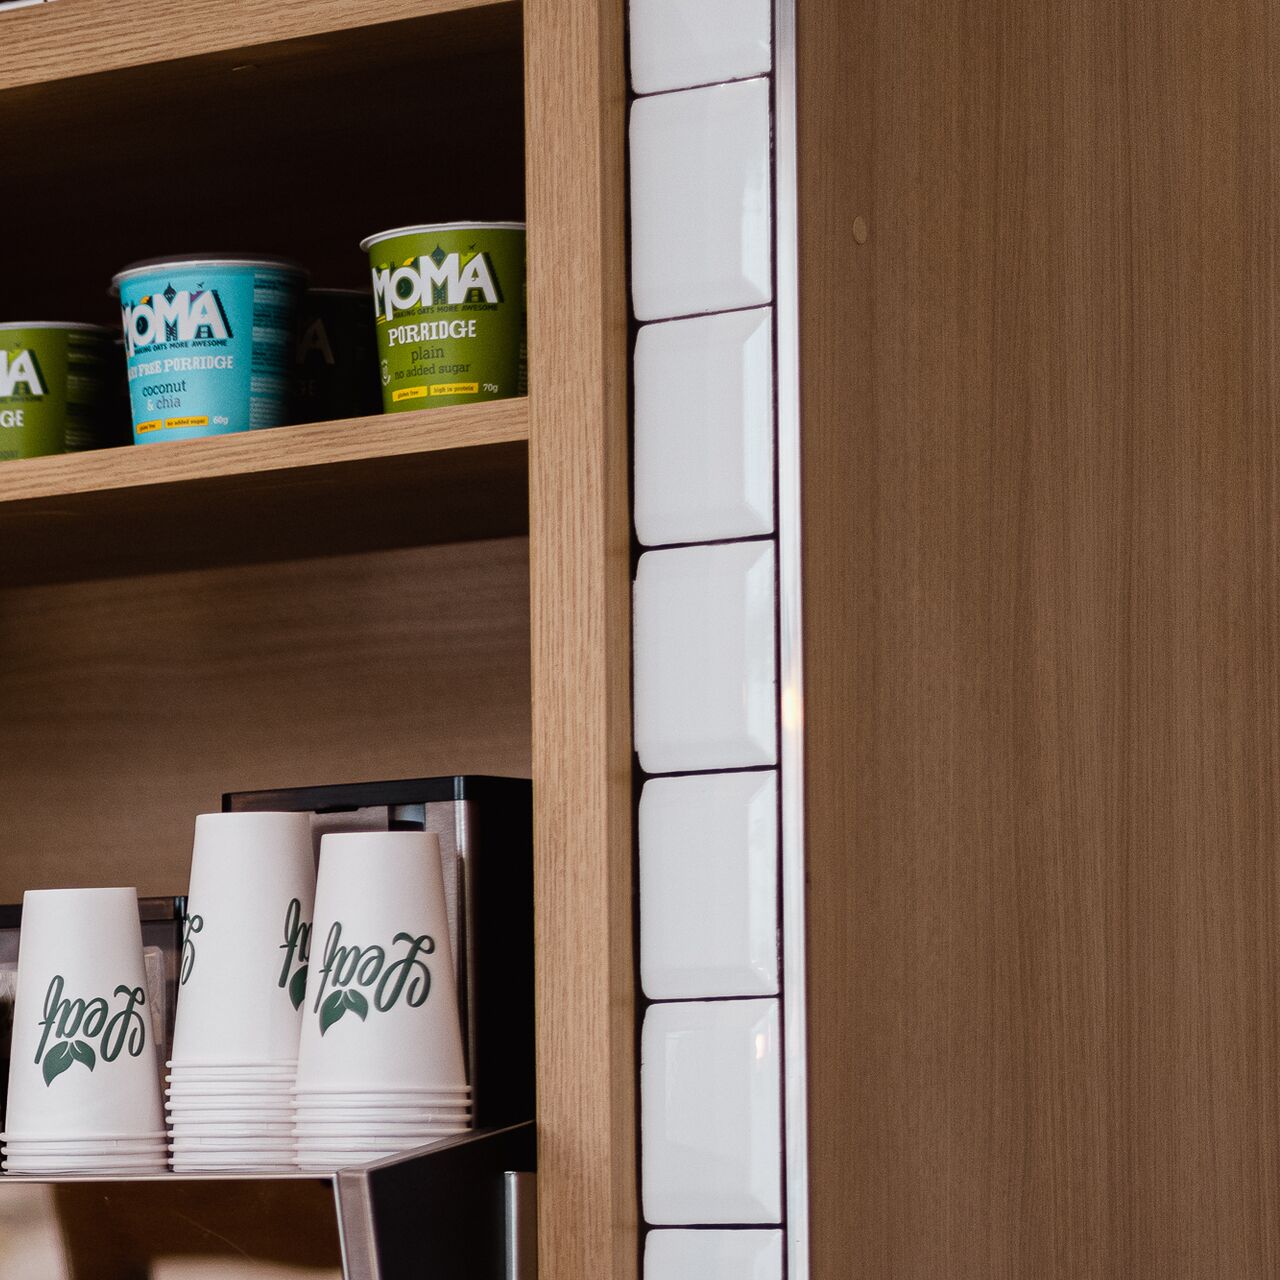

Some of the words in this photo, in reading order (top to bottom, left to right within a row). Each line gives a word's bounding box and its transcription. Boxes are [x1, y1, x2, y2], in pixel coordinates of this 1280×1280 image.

[372, 252, 498, 321] MOMA
[388, 319, 477, 346] PORRIDGE
[411, 346, 445, 363] plain
[164, 355, 234, 374] PORRIDGE
[394, 368, 404, 380] no
[406, 364, 435, 378] added
[438, 363, 471, 376] sugar
[142, 380, 187, 398] coconut
[482, 383, 498, 393] 70g
[156, 394, 181, 410] chia
[314, 920, 435, 1015] Leaf
[34, 974, 145, 1065] Leaf
